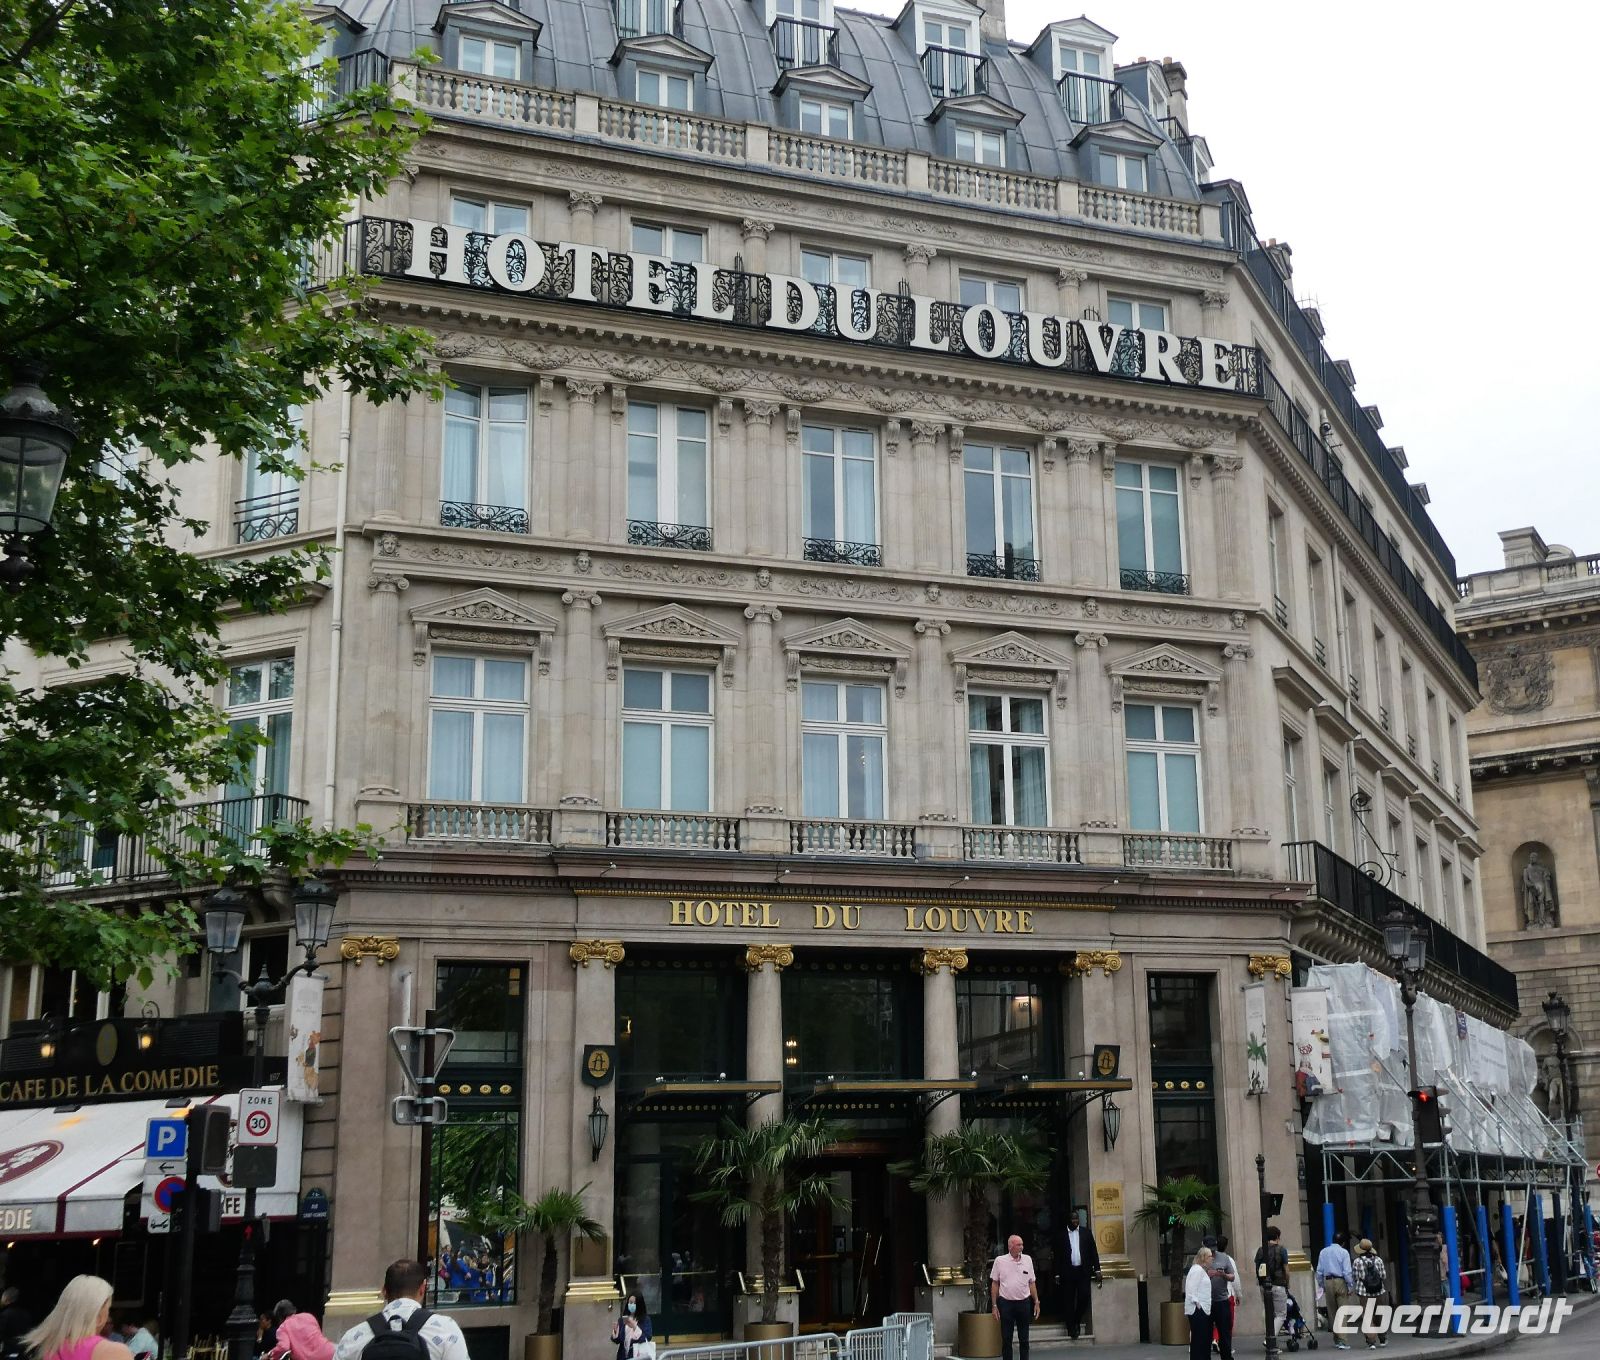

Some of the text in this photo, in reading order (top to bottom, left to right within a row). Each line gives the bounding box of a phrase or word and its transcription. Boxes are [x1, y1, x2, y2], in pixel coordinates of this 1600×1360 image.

[403, 218, 1238, 390] HOTEL DU LOUVRE
[669, 900, 1034, 933] HOTEL DU LOUVRE
[0, 1065, 220, 1101] CAFE DE LA COMEDIE
[247, 1096, 273, 1105] ZONE
[251, 1118, 266, 1129] 30
[157, 1126, 177, 1151] P
